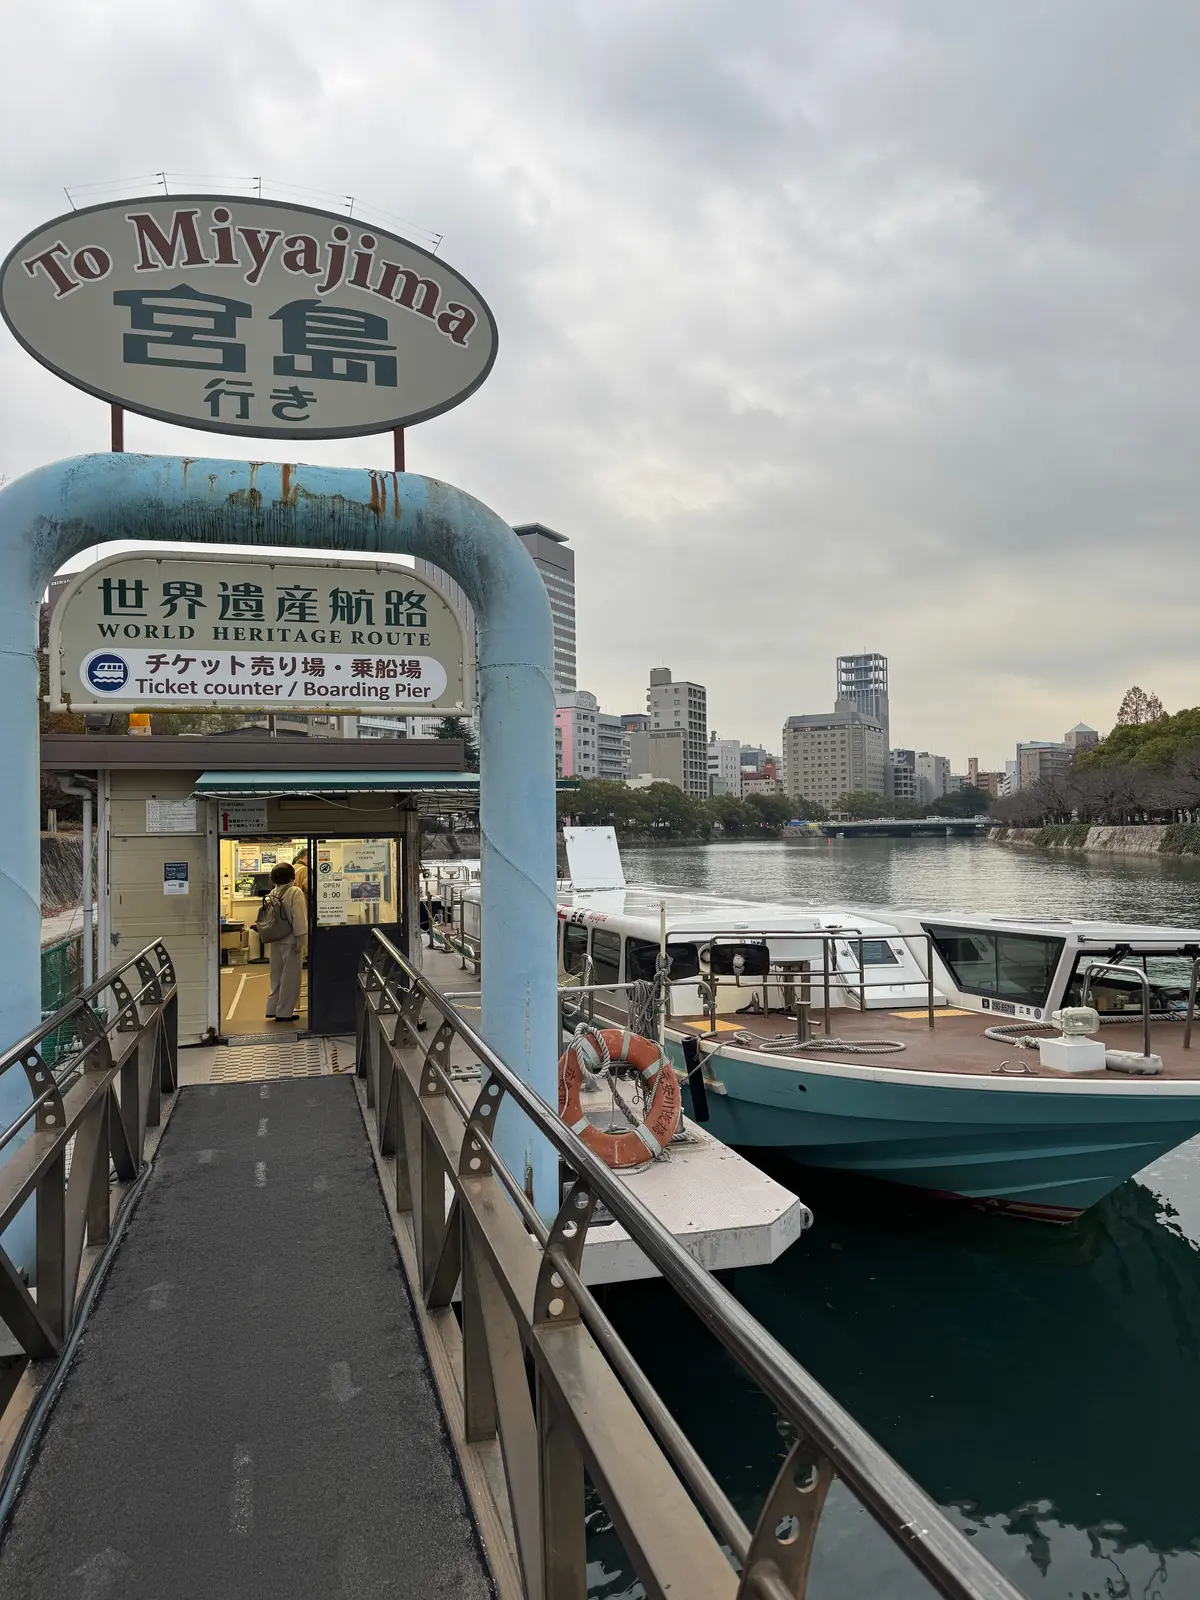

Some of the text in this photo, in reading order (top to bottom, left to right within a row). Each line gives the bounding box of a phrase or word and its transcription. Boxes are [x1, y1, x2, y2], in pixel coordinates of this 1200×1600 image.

[25, 207, 477, 347] To Miyajima
[113, 283, 398, 388] 宮島
[203, 377, 318, 421] 行き
[98, 577, 428, 628] 世界遺産航路
[97, 623, 431, 646] WORLD HERITAGE ROUTE
[145, 653, 422, 679] チケット売り場・乗船場
[135, 678, 431, 701] Ticket counter / Boarding Pier
[322, 891, 341, 899] 8:00
